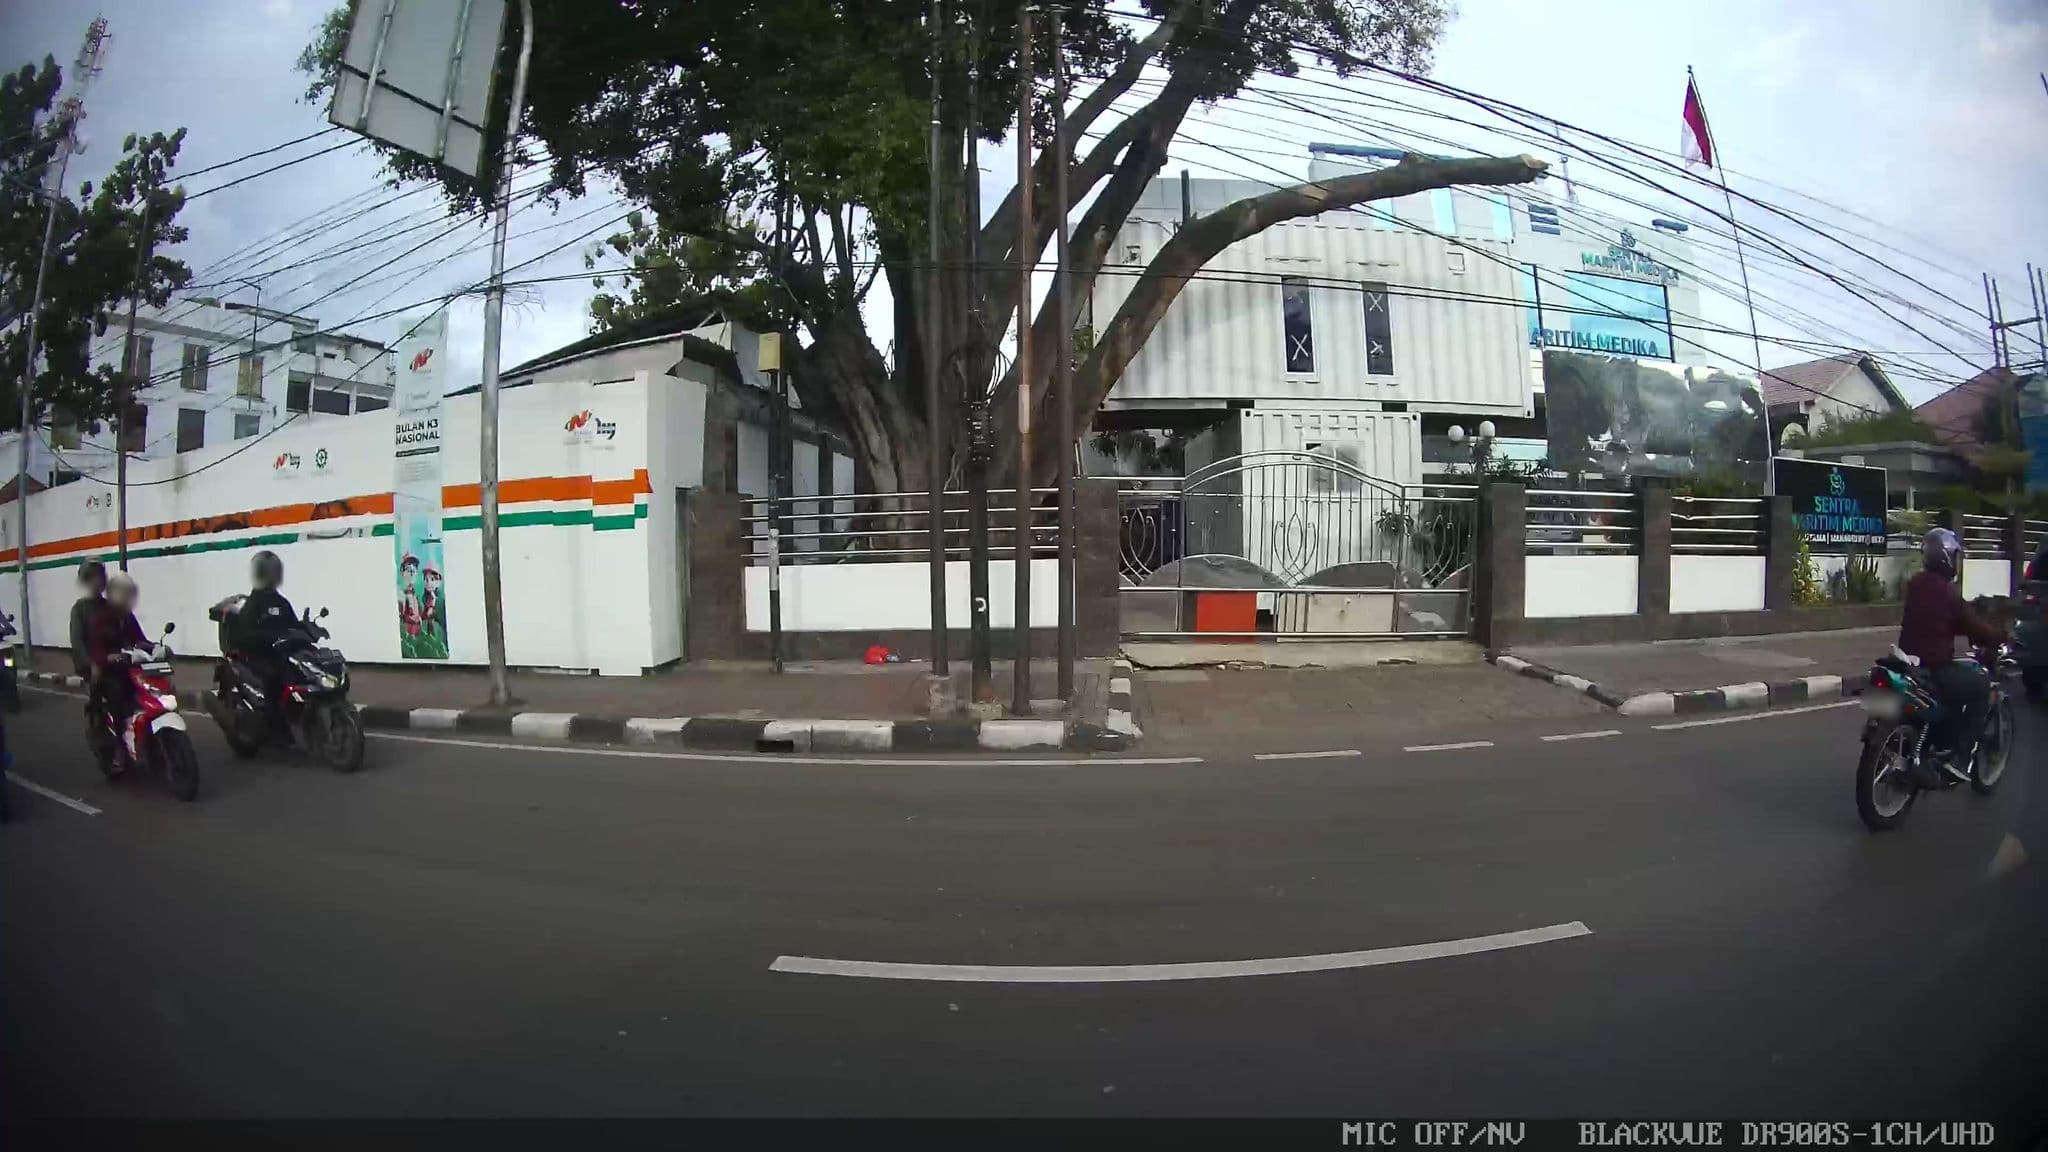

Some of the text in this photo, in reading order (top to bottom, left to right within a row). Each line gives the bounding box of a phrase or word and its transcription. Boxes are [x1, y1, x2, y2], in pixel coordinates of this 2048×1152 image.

[1582, 251, 1634, 274] MARITIM
[1596, 332, 1659, 356] MEDIKA
[396, 418, 439, 434] BULAN K3
[396, 430, 440, 445] NASIONAL
[1814, 495, 1860, 513] SENTRA
